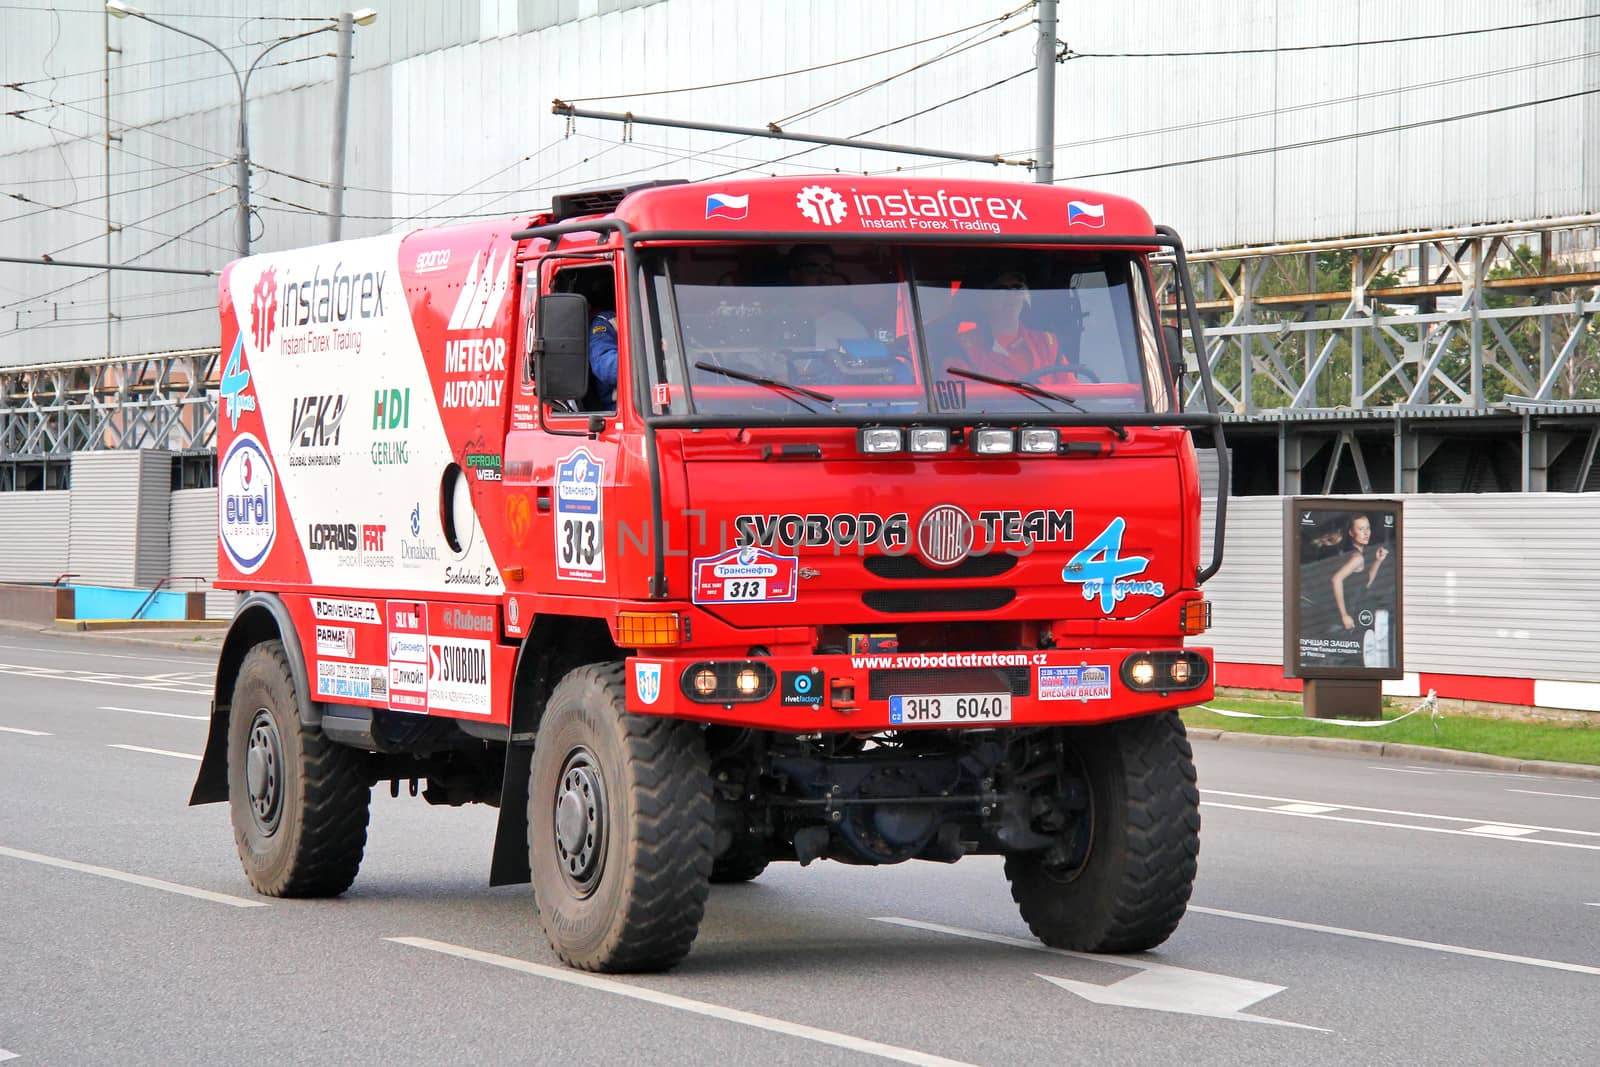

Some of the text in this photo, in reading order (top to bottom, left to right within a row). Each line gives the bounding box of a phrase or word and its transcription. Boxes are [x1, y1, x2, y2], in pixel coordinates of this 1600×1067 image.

[852, 188, 1028, 221] instaforex
[861, 217, 1001, 234] Instant Forex Trading
[281, 261, 386, 328] instaforex
[280, 329, 362, 356] Instant Forex Trading
[445, 337, 505, 373] METEOR
[442, 374, 504, 408] AUTODÍLY
[290, 394, 344, 447] VEKA
[372, 388, 410, 430] HDI
[290, 455, 341, 467] GLOBAL SHIPBUILDING
[371, 440, 409, 465] GERLING
[467, 455, 502, 468] OFFROAD
[226, 485, 269, 525] eurol
[309, 523, 357, 552] LOPRAIS
[563, 519, 595, 566] 313
[735, 509, 1074, 561] SVOBODA TATRA TEAM
[718, 566, 774, 576] Транснефть
[1062, 516, 1150, 614] 4
[730, 581, 760, 598] 313
[1114, 579, 1164, 599] games
[453, 609, 494, 633] Rubena
[443, 645, 487, 685] SVOBODA
[851, 653, 1047, 669] www.svobodatatrateam.cz
[399, 669, 424, 685] ЛУКОЙЛ
[1078, 686, 1109, 697] BALKAN
[906, 697, 1002, 720] 3H3 6040
